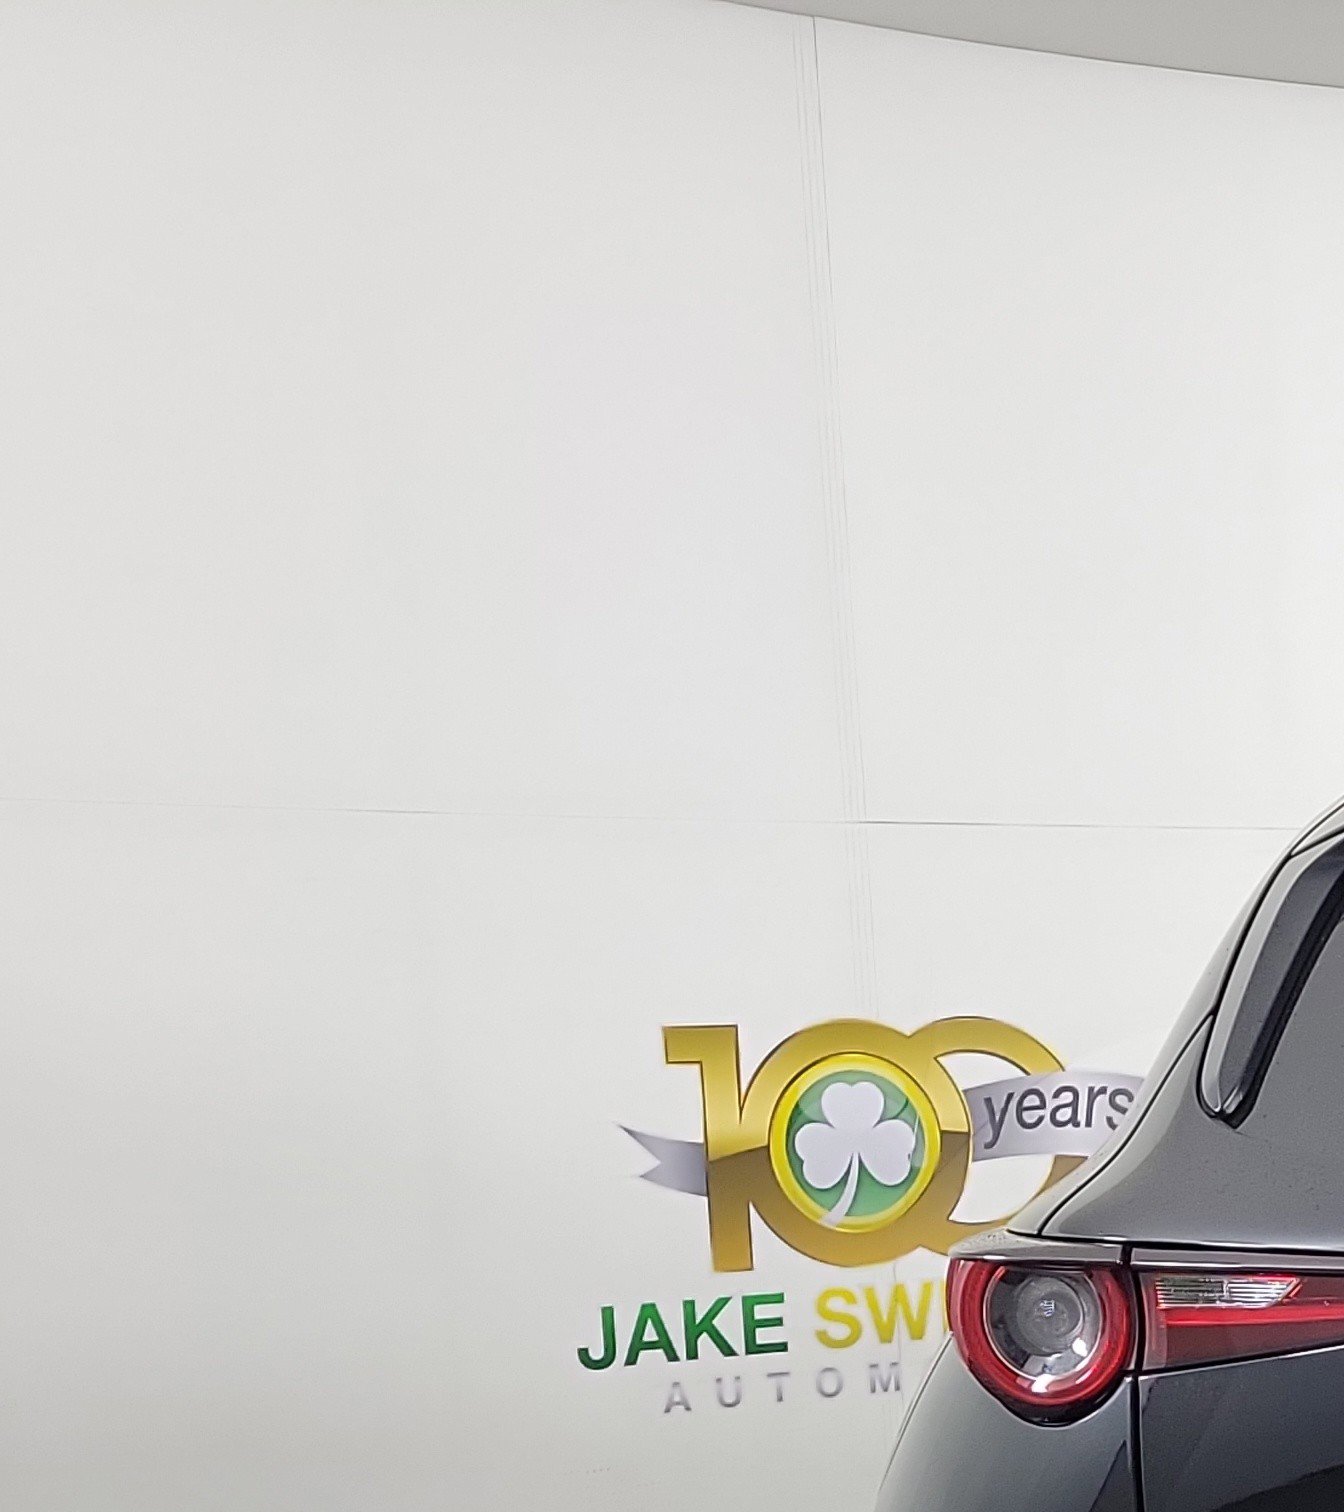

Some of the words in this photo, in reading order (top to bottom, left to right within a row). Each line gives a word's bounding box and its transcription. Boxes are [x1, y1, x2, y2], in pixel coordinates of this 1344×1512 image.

[661, 1015, 1088, 1273] 100
[576, 1292, 790, 1371] JAKE
[663, 1362, 902, 1414] AUTOM
